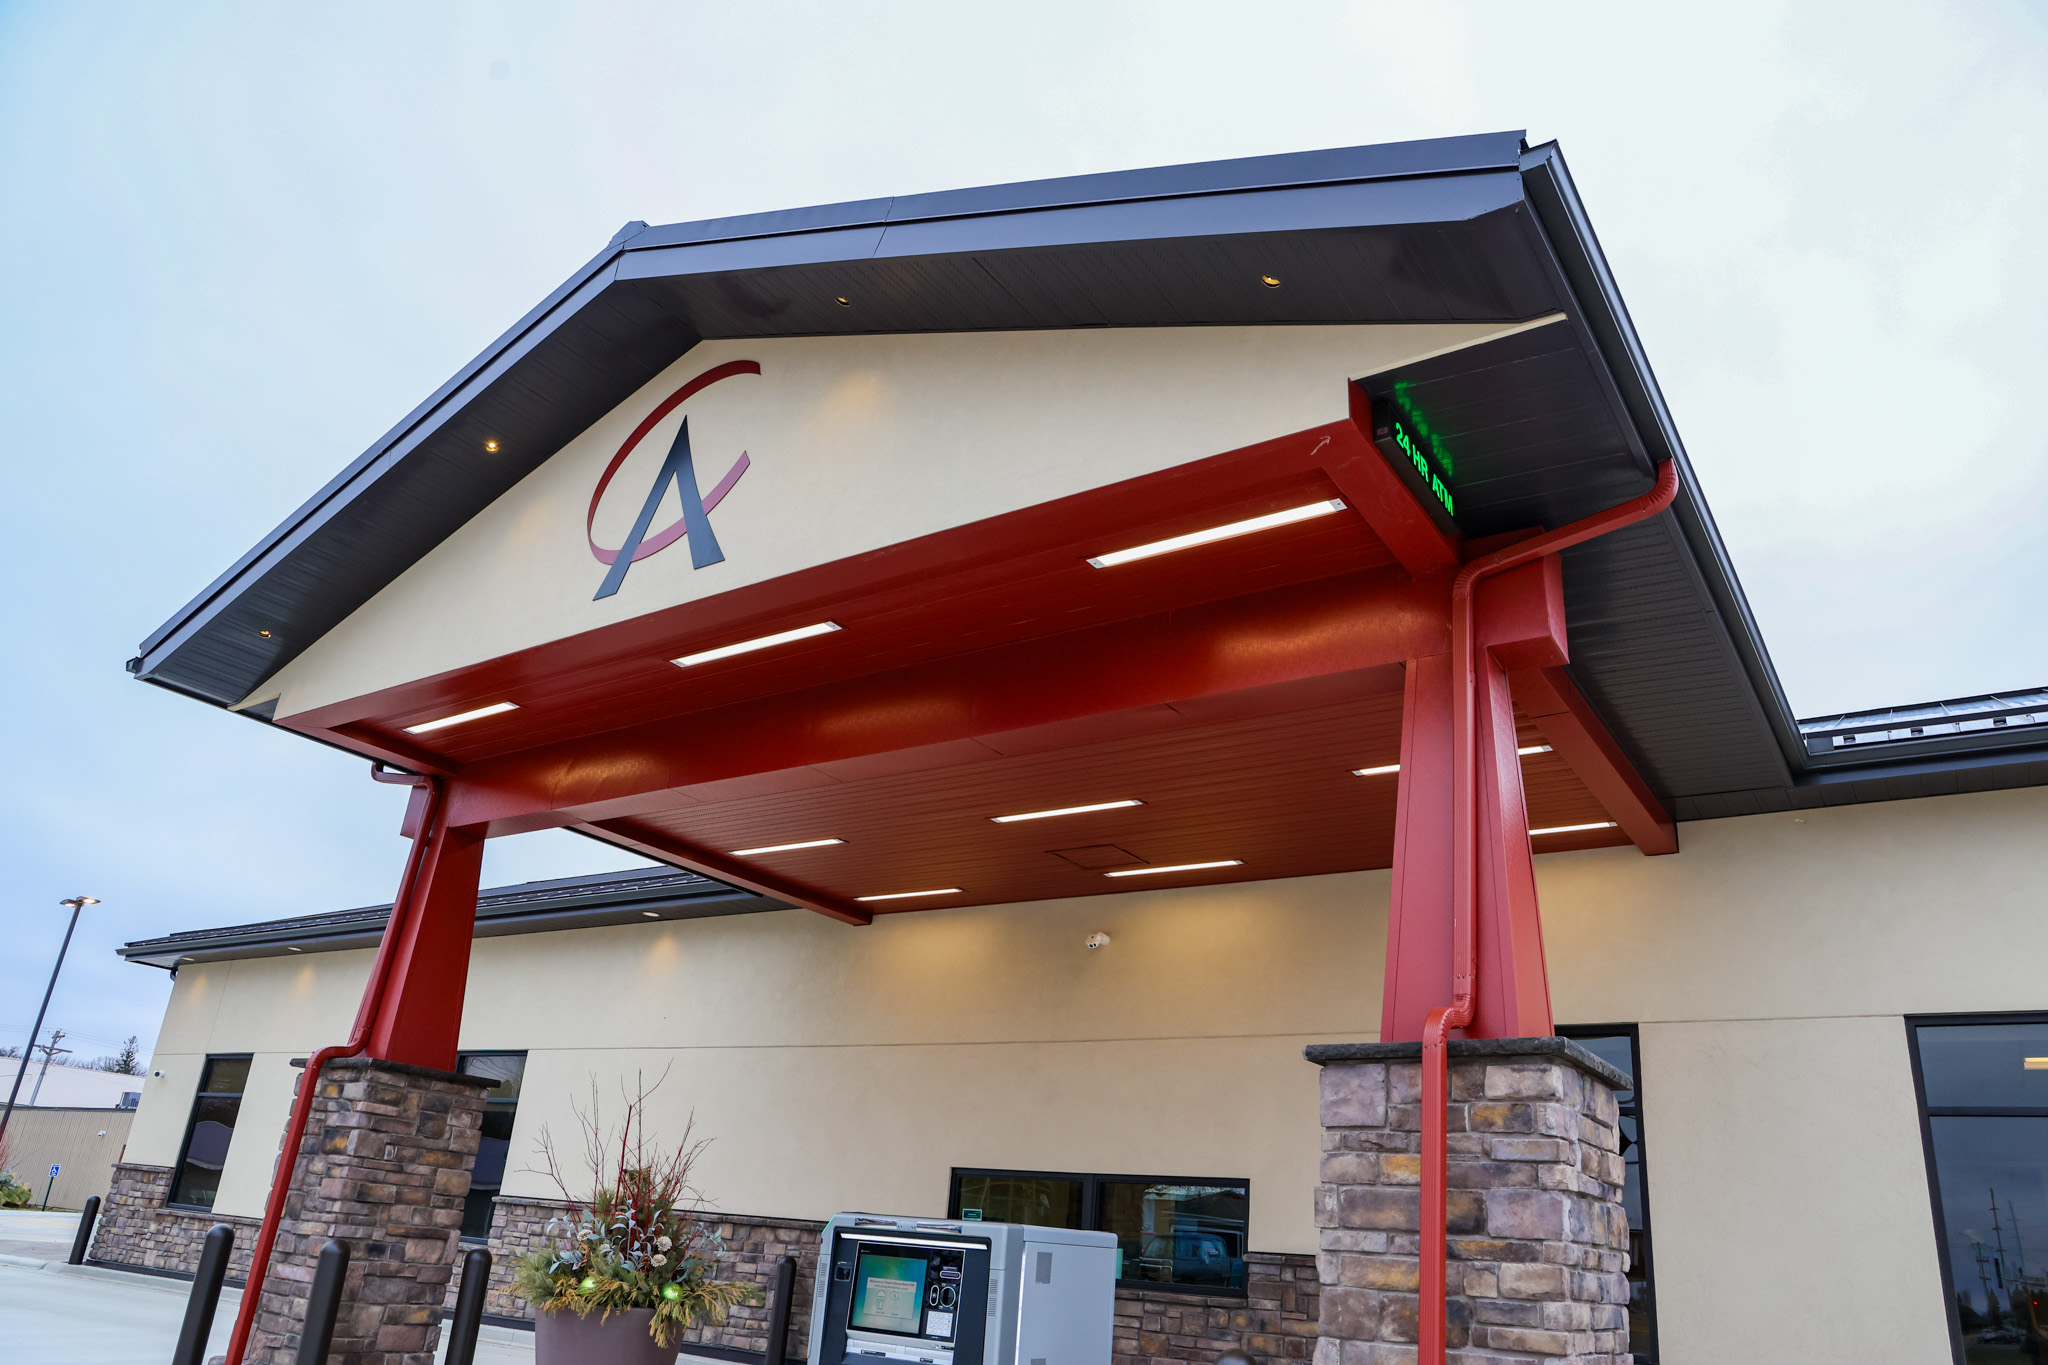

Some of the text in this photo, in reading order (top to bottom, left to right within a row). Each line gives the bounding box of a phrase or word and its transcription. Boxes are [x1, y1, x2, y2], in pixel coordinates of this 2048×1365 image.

[1395, 422, 1454, 516] 24 HR ATM
